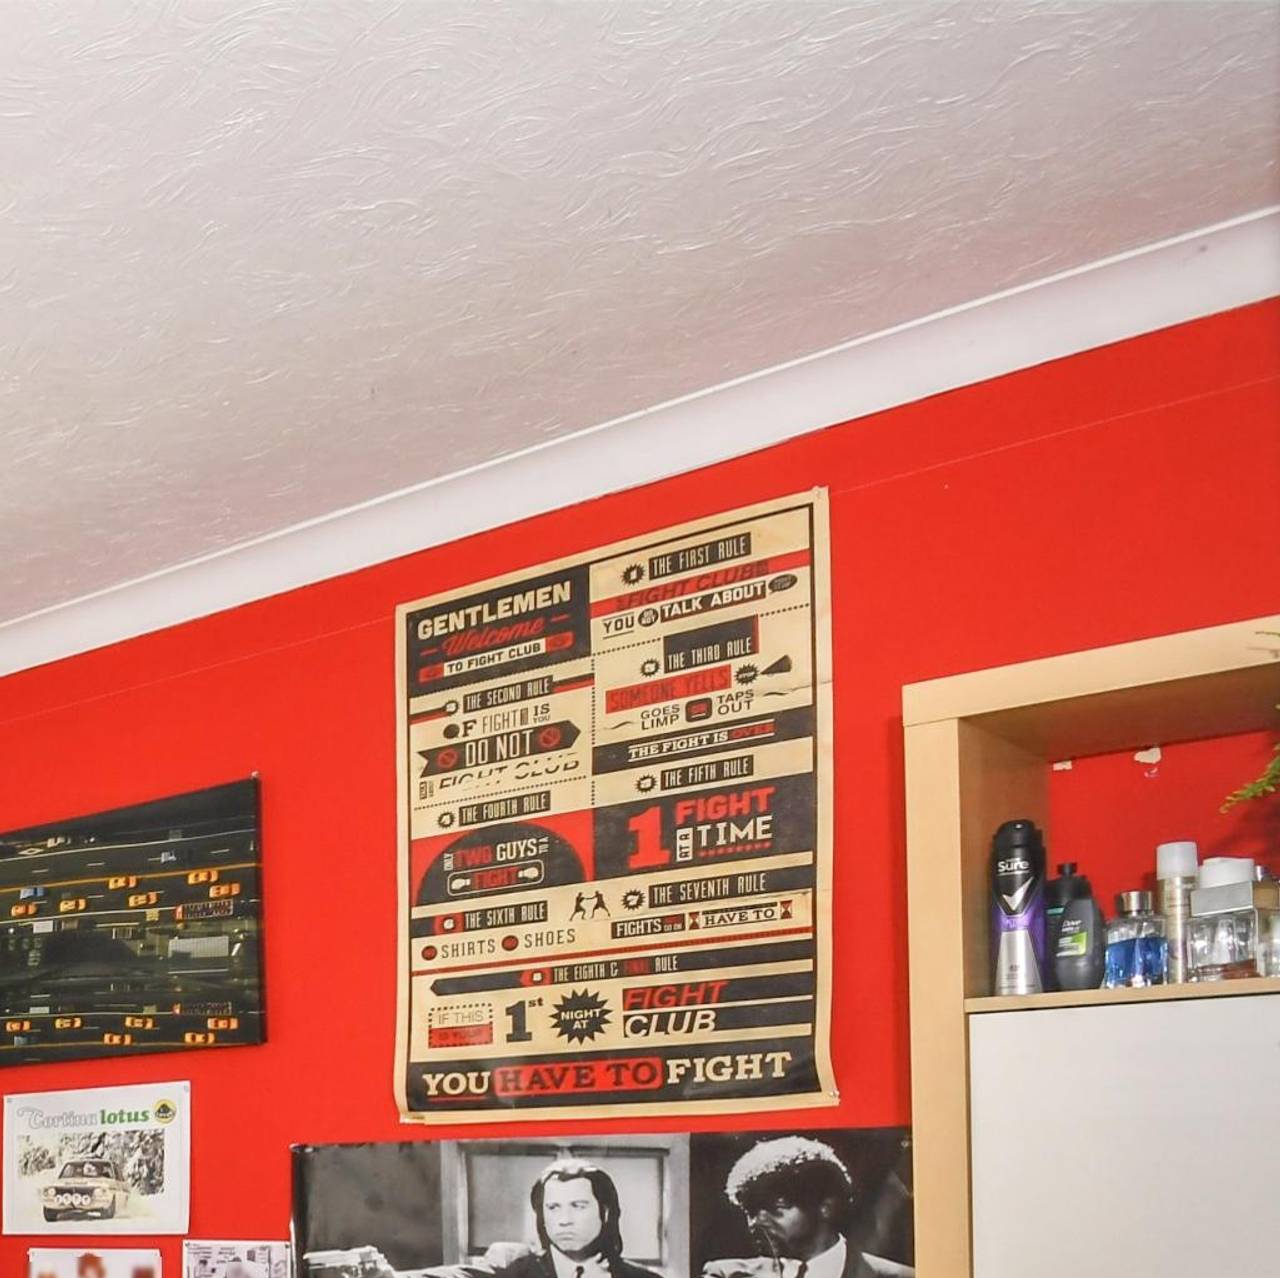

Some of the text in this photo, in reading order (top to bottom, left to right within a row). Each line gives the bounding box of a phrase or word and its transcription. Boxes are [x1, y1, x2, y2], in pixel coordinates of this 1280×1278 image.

[652, 557, 673, 576] THE
[678, 545, 710, 569] FIRST
[718, 536, 747, 561] RULE
[417, 580, 571, 640] GENTLEMEN
[603, 615, 635, 635] YOU
[662, 598, 704, 619] TALK
[711, 582, 764, 609] ABOUT
[442, 617, 546, 656] Welcome
[447, 643, 541, 674] TO FIGHT CLUB
[668, 637, 752, 670] THE THIRD RULE
[467, 678, 549, 710] THE SECOND RULE
[717, 689, 755, 704] TAPS
[717, 699, 753, 715] OUT
[482, 709, 518, 734] FIGHT
[533, 703, 551, 717] IS
[641, 703, 681, 719] GOES
[641, 714, 680, 730] LIMP
[465, 729, 534, 767] DO NOT
[628, 745, 659, 761] THE
[662, 734, 710, 752] FIGHT
[713, 731, 729, 743] IS
[664, 757, 750, 787] THE FIFTH RULE
[462, 808, 477, 825] THE
[483, 801, 517, 820] FOURTH
[523, 793, 546, 814] RULE
[627, 786, 776, 871] 1 FIGHT
[697, 815, 773, 848] TIME
[496, 838, 537, 861] GUYS
[997, 860, 1030, 873] Sure
[654, 887, 672, 905] THE
[680, 879, 729, 901] SEVENTH
[737, 873, 767, 893] RULE
[465, 903, 545, 929] THE SIXTH RULE
[616, 918, 662, 937] FIGHTS
[705, 912, 748, 926] HAVE
[752, 908, 776, 921] TO
[441, 928, 576, 959] SHIRTS SHOES
[554, 967, 569, 982] THE
[574, 964, 605, 981] EIGHTH
[655, 955, 678, 972] RULE
[625, 979, 729, 1010] FIGHT
[438, 1010, 484, 1024] IF THIS
[505, 997, 544, 1043] 1st
[561, 1008, 602, 1021] NIGHT
[572, 1020, 589, 1030] AT
[624, 1009, 717, 1039] CLUB
[422, 1051, 793, 1097] YOU HAVE TO FIGHT
[100, 1109, 150, 1126] lotus
